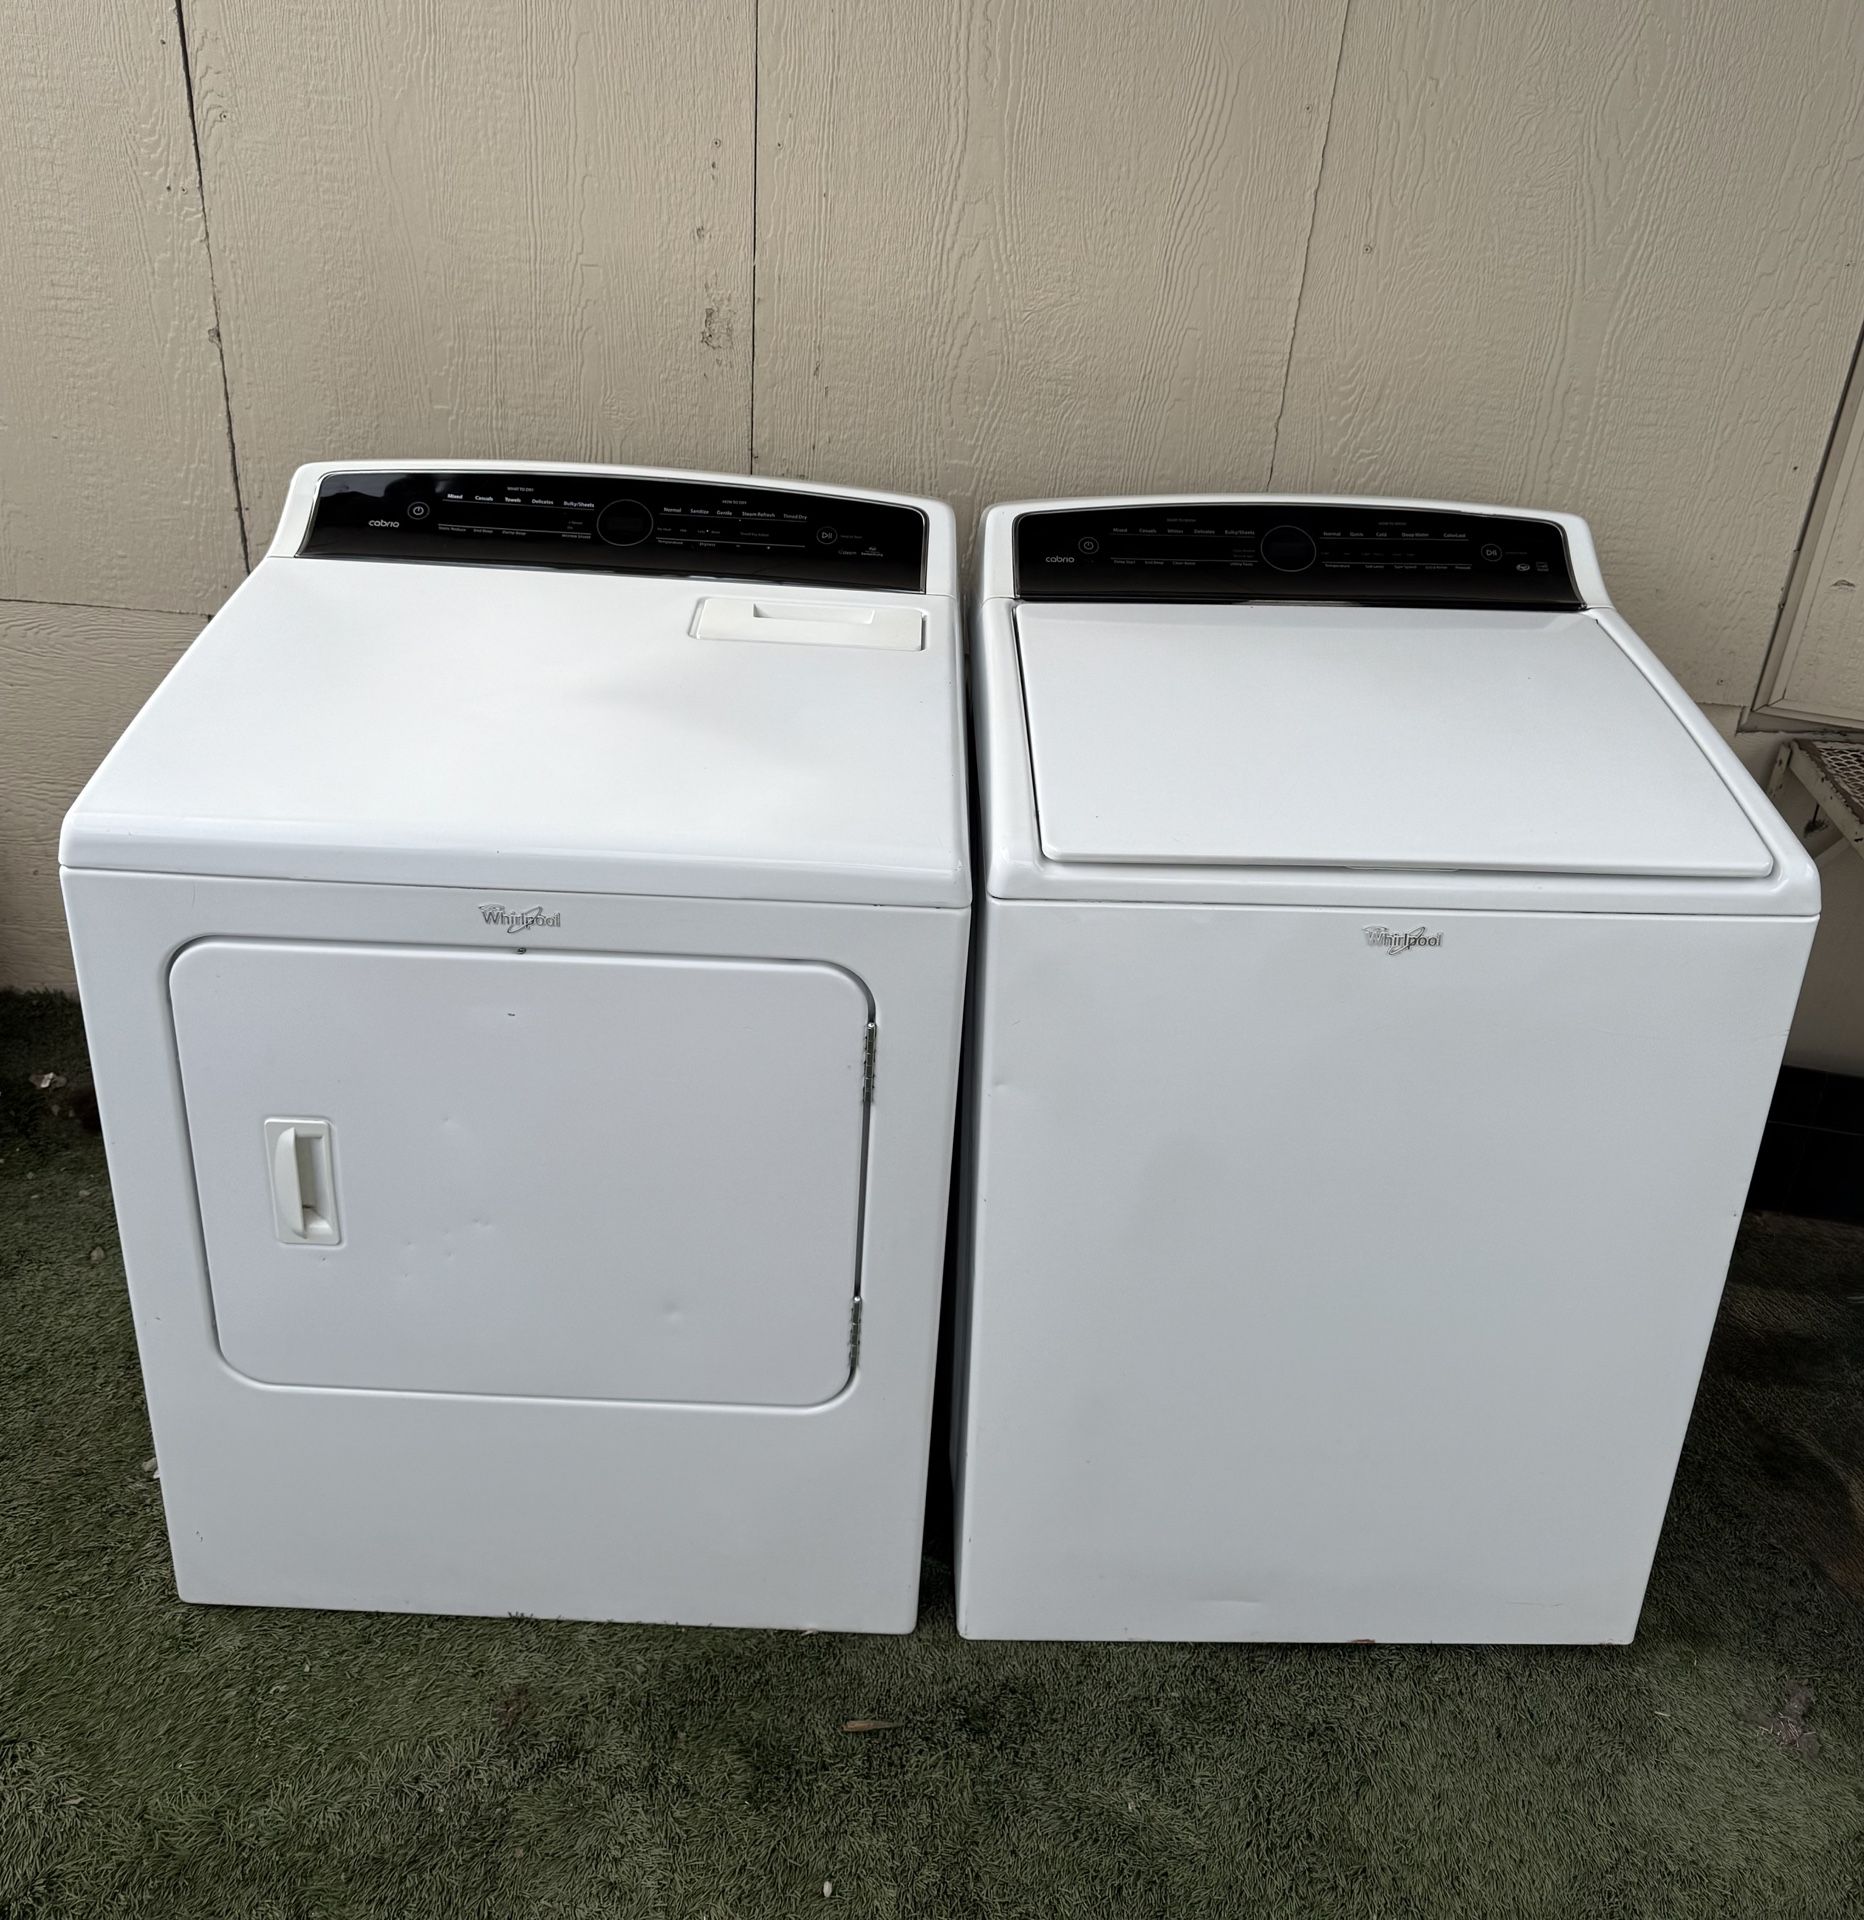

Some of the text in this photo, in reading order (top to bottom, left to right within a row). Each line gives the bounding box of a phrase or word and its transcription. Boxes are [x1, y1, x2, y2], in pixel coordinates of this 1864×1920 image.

[563, 500, 595, 508] Bulky/Sheets
[368, 519, 400, 529] cabrio
[1045, 555, 1076, 564] cabrio
[479, 904, 561, 933] Whirlpool
[1361, 926, 1445, 955] Whirlpool
